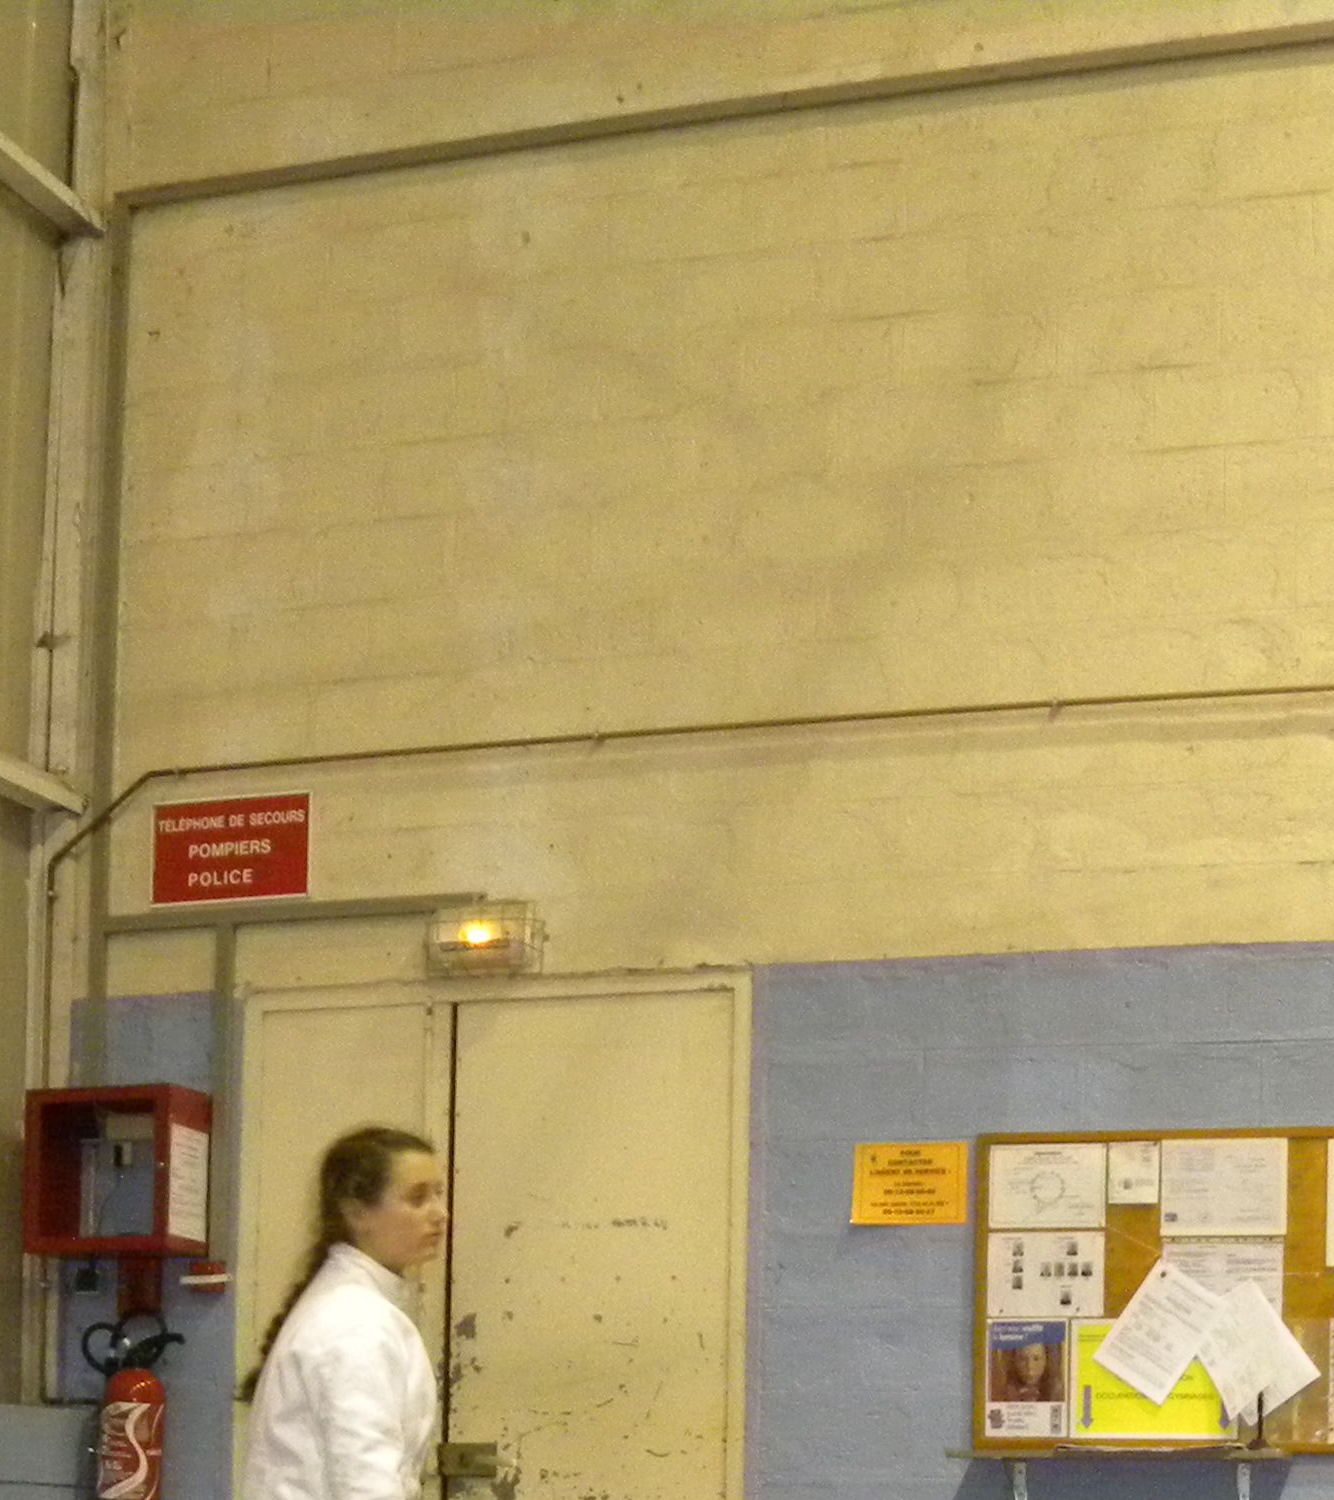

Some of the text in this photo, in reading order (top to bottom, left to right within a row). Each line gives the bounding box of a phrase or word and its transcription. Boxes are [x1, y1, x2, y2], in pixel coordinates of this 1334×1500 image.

[229, 814, 245, 828] DE
[249, 809, 306, 826] SECOURS
[188, 838, 272, 859] POMPIERS
[188, 868, 254, 887] POLICE
